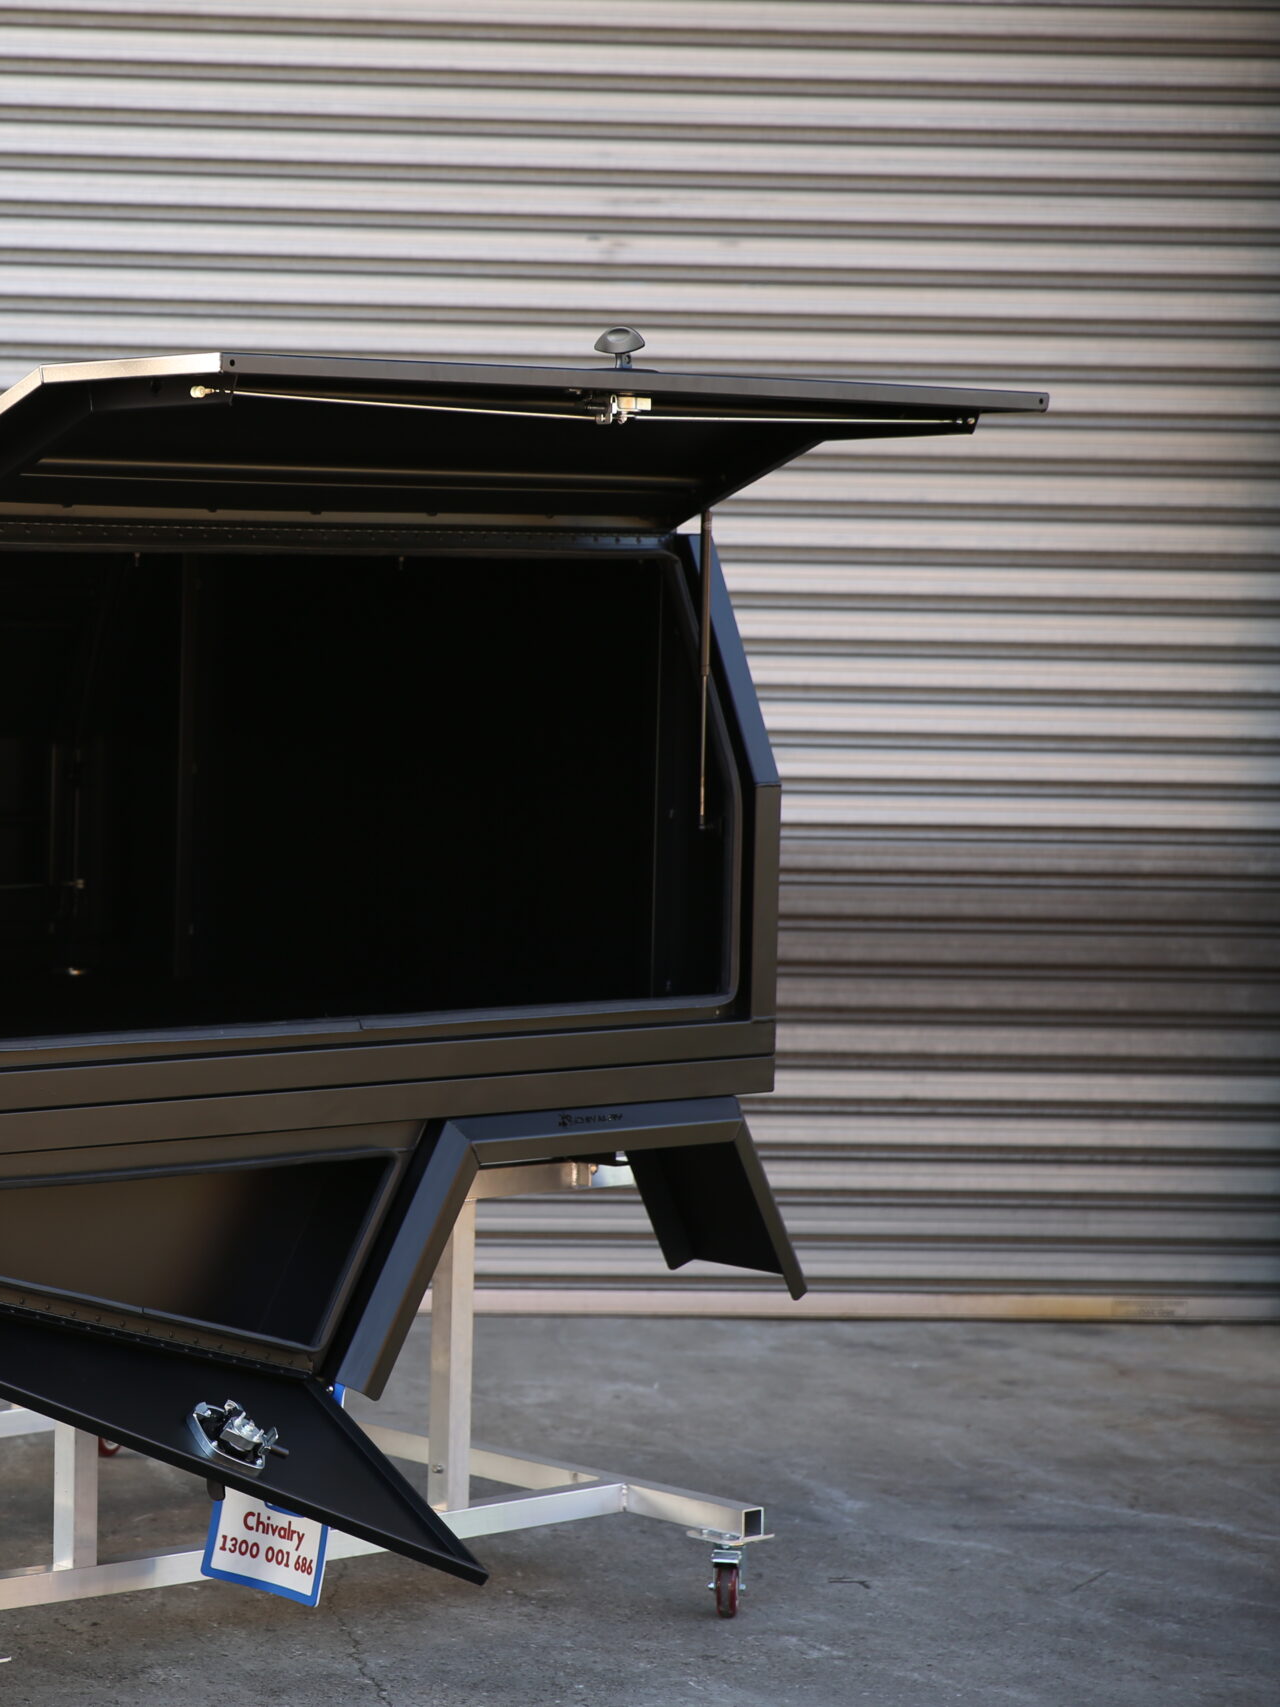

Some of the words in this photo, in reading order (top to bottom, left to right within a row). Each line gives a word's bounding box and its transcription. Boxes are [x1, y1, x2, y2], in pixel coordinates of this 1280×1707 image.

[243, 1511, 305, 1551] Chivalry
[219, 1534, 260, 1559] 1300
[265, 1546, 290, 1568] 001
[294, 1554, 313, 1576] 686
